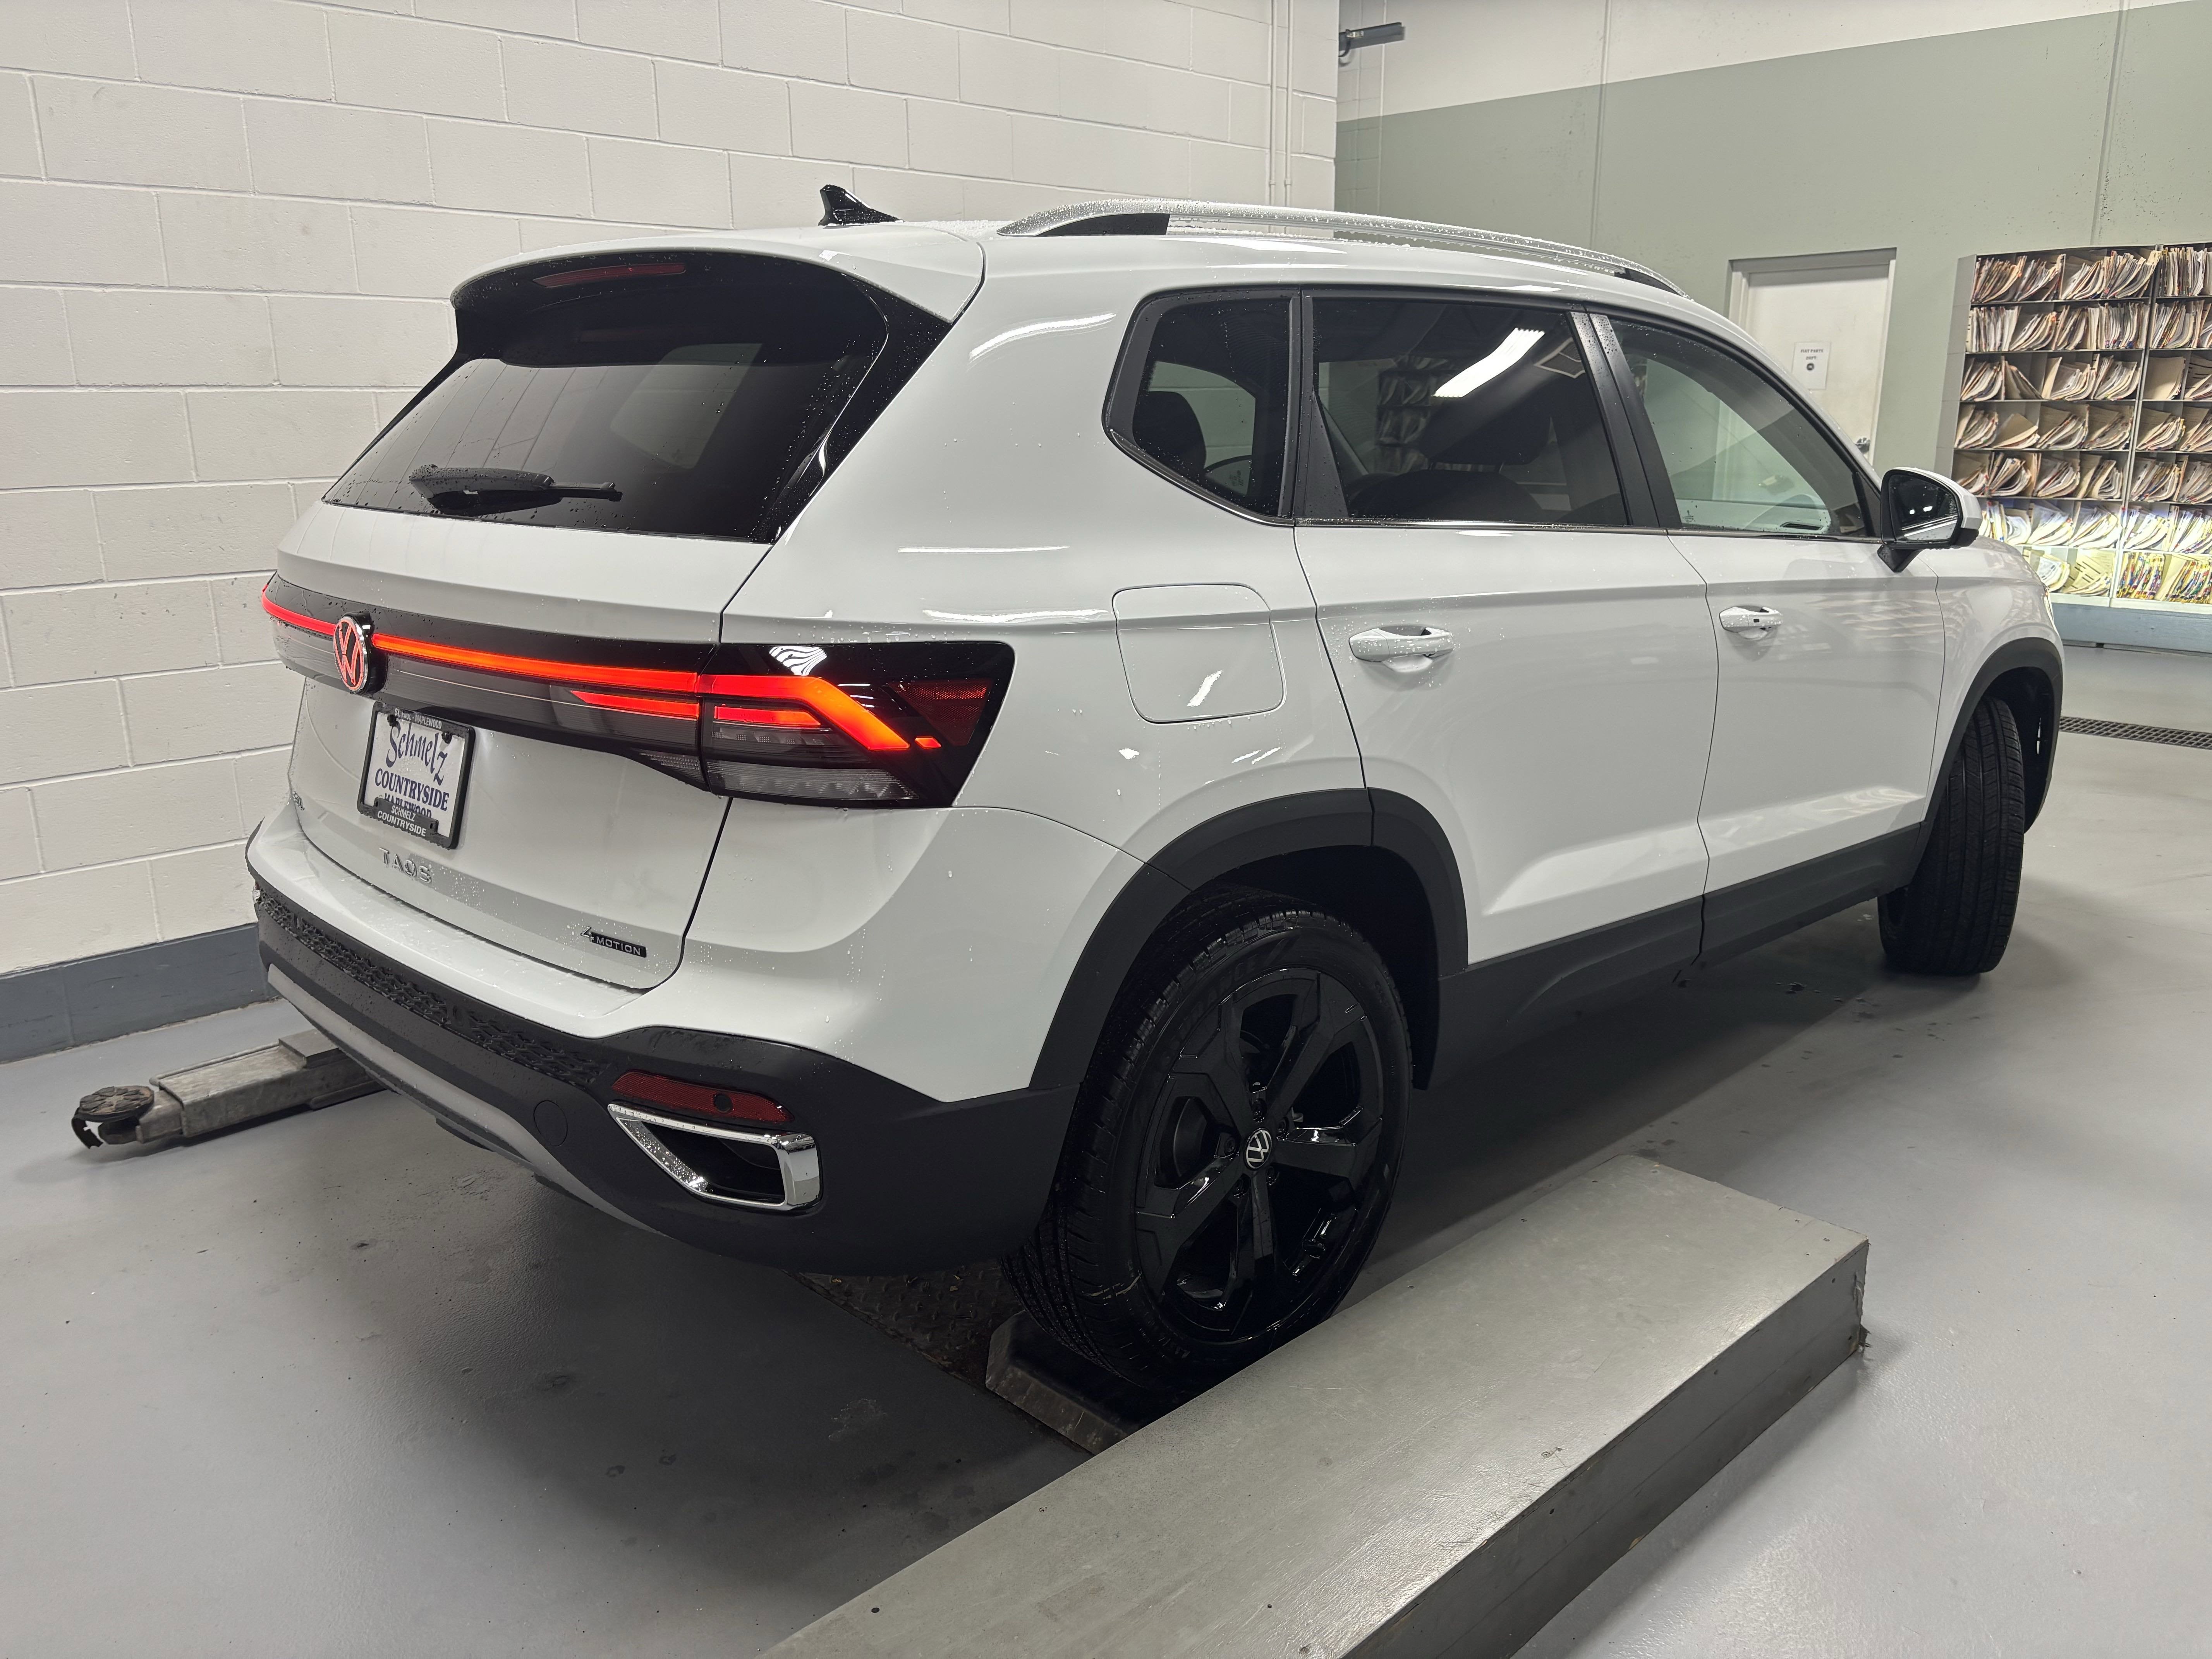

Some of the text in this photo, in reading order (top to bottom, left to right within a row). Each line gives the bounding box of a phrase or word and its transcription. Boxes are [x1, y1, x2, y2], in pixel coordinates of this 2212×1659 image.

[415, 714, 442, 729] MAPLEWOOD
[386, 720, 448, 786] Schmelz
[375, 768, 450, 811] COUNTRYSIDE
[377, 811, 427, 836] COUNTRYSIDE
[391, 805, 416, 822] SCHMELZ
[379, 847, 432, 883] TAOS
